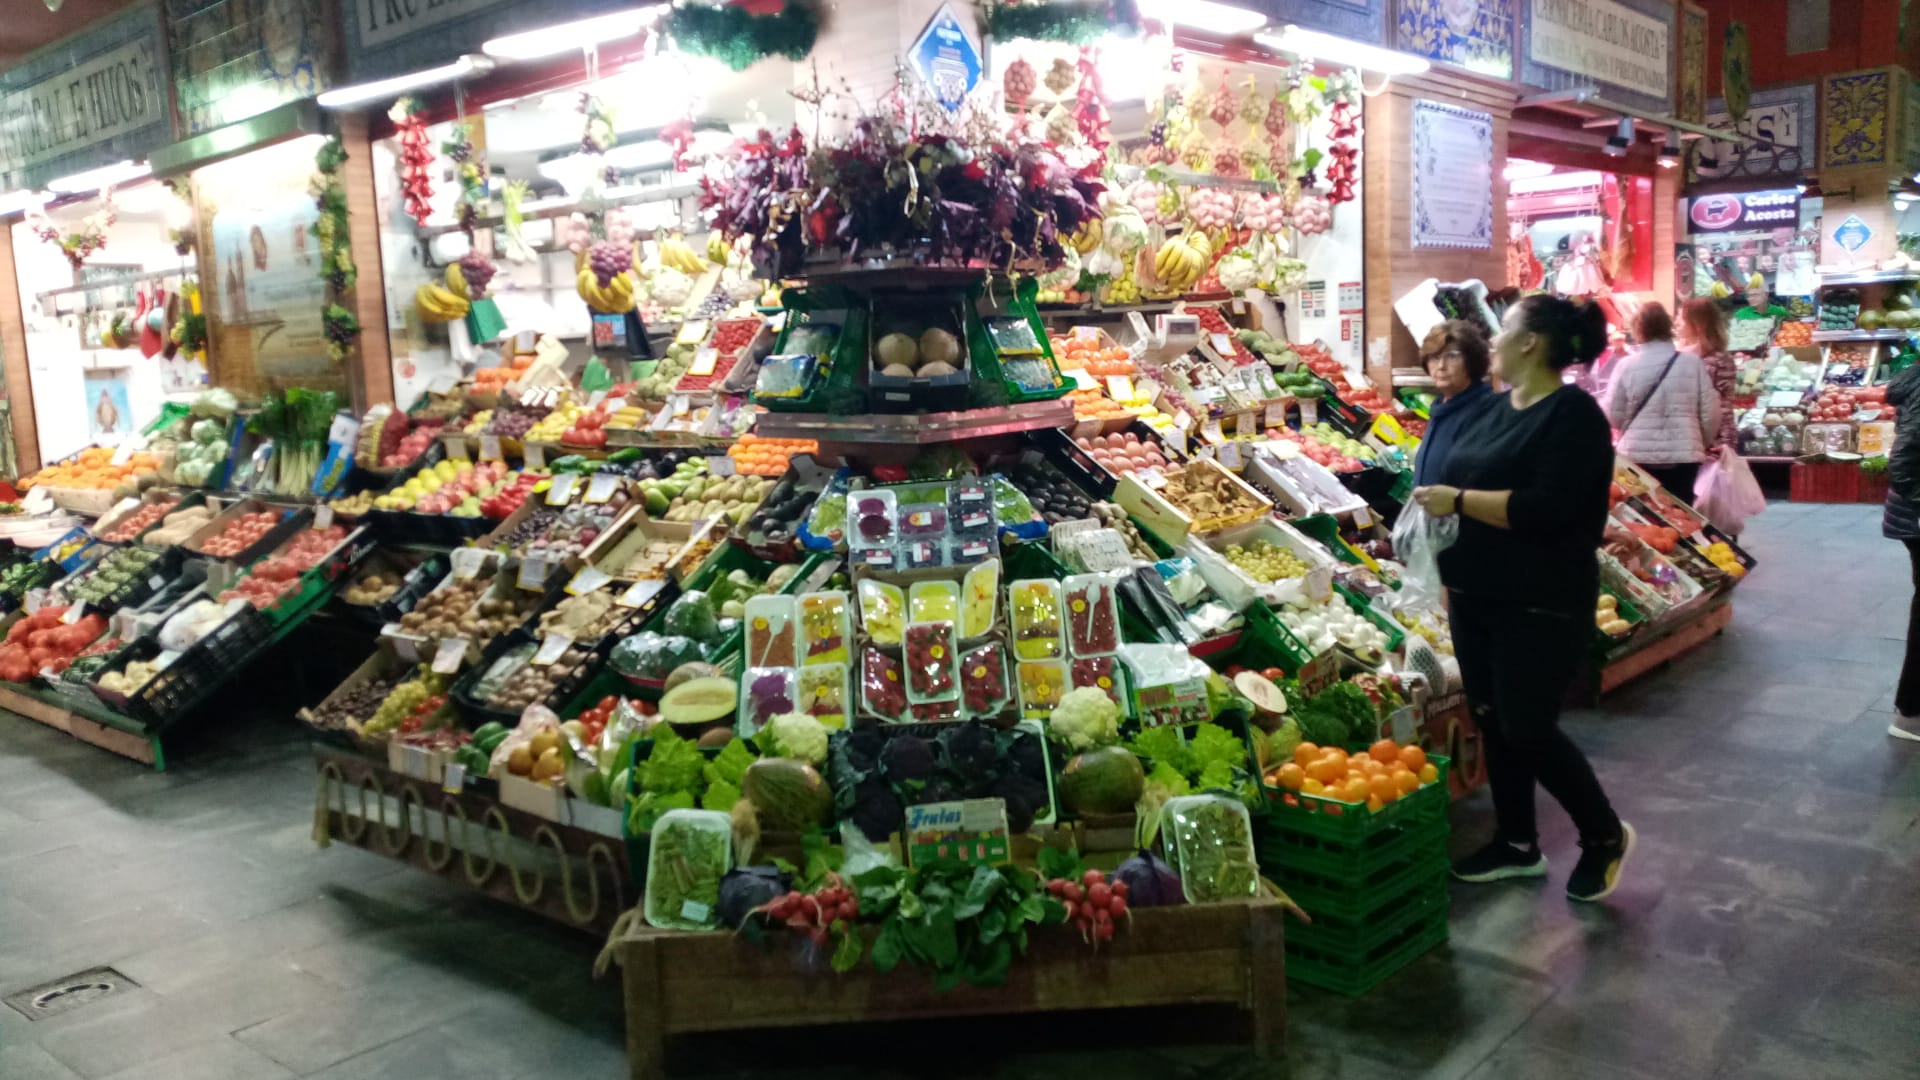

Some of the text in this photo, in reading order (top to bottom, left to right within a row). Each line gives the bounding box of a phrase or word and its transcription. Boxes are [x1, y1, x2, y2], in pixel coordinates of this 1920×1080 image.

[1744, 194, 1796, 207] Carlos
[1743, 209, 1796, 222] Acosta
[910, 807, 962, 829] Frutas
